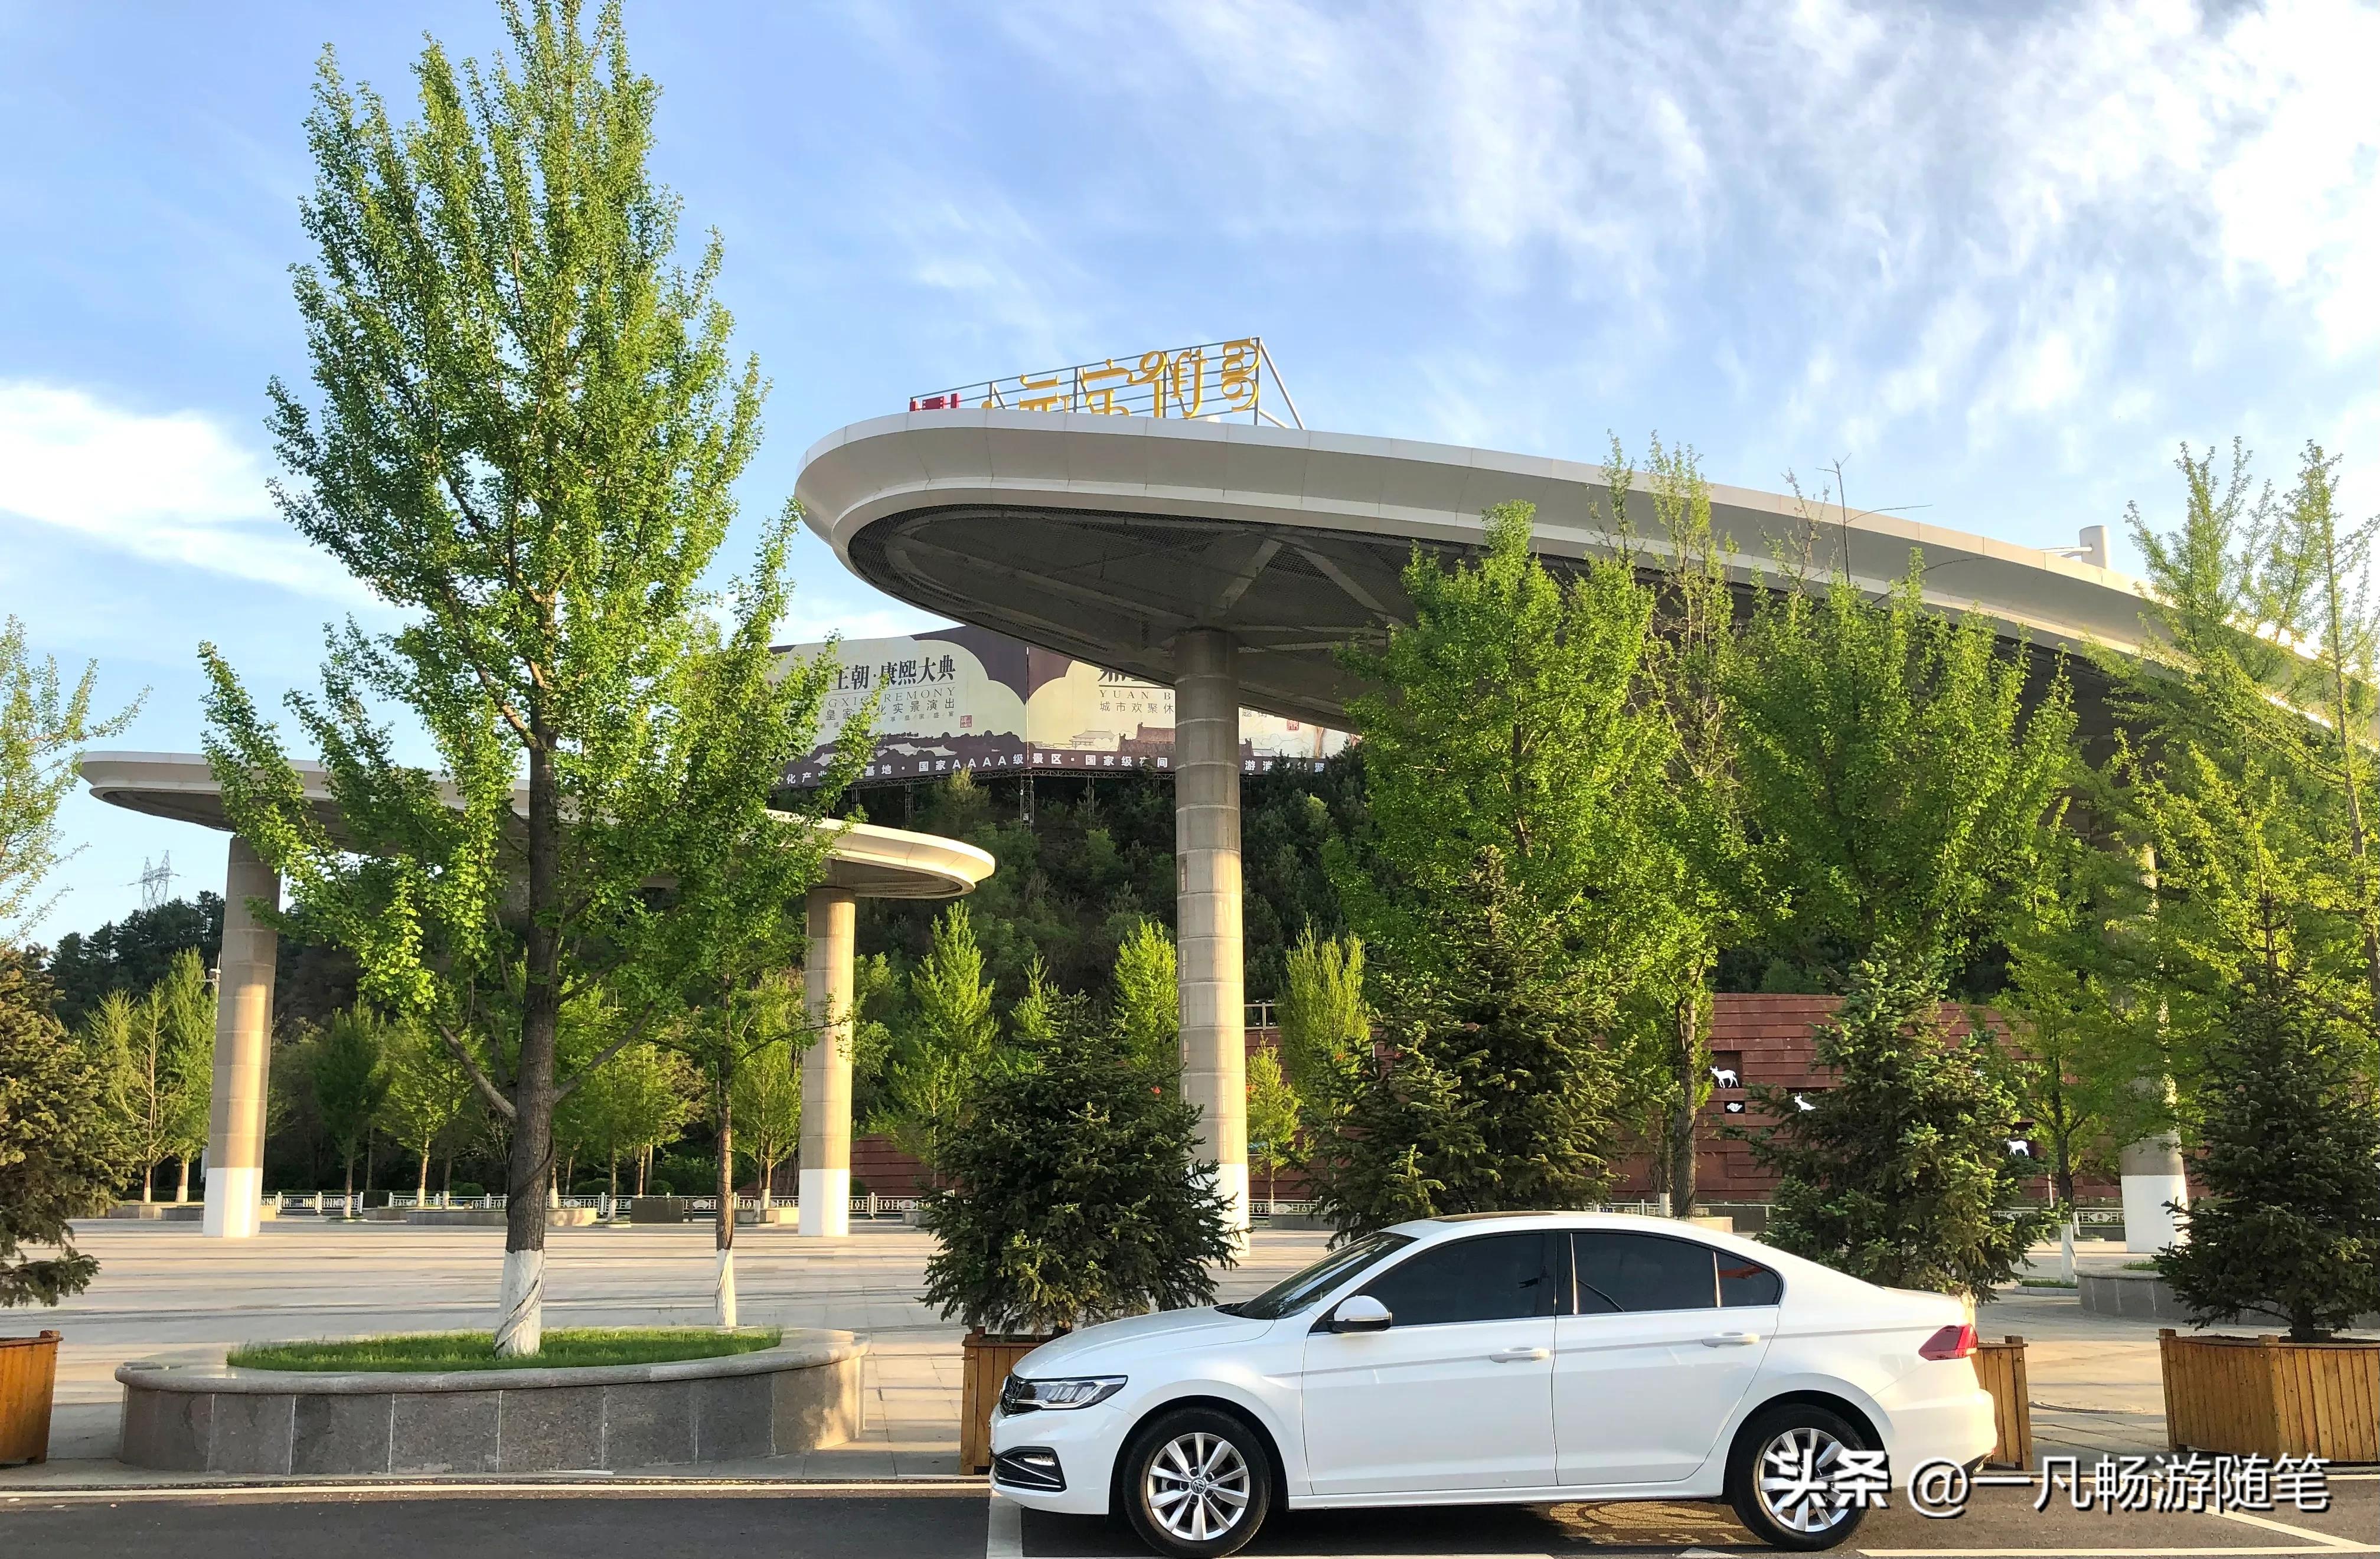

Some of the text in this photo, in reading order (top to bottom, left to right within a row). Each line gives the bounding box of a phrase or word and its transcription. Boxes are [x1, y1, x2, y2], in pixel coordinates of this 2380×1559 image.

[1099, 689, 1150, 700] YUAN
[1099, 701, 1174, 714] 城市欢聚休
